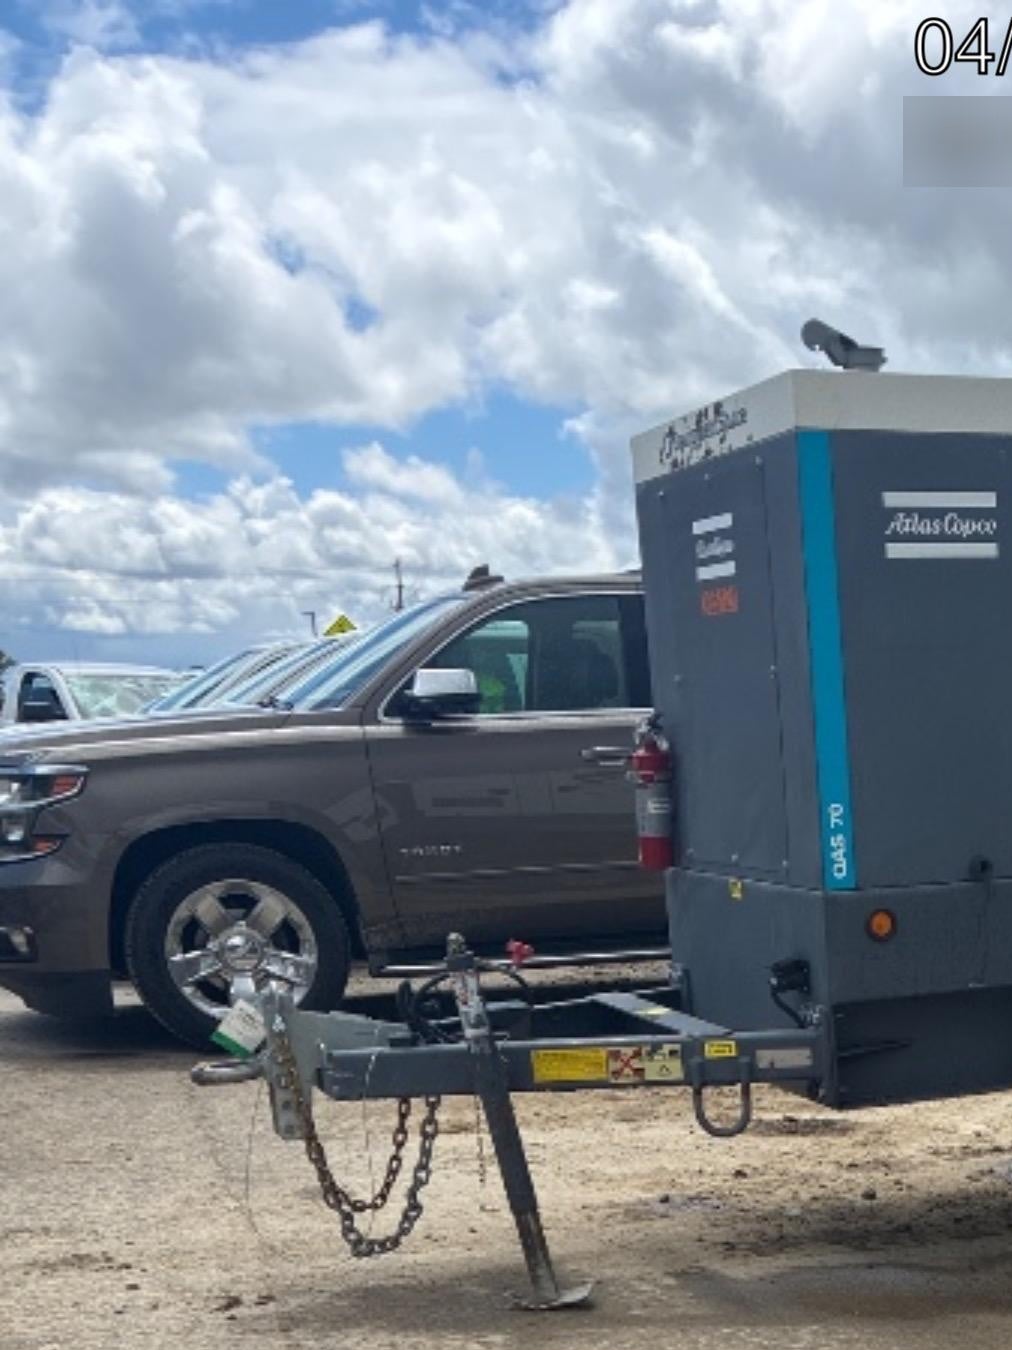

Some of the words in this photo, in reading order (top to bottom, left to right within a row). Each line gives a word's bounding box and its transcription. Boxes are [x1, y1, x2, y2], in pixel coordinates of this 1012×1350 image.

[884, 511, 940, 536] Atlas
[830, 802, 844, 829] 70
[831, 833, 848, 880] QAS
